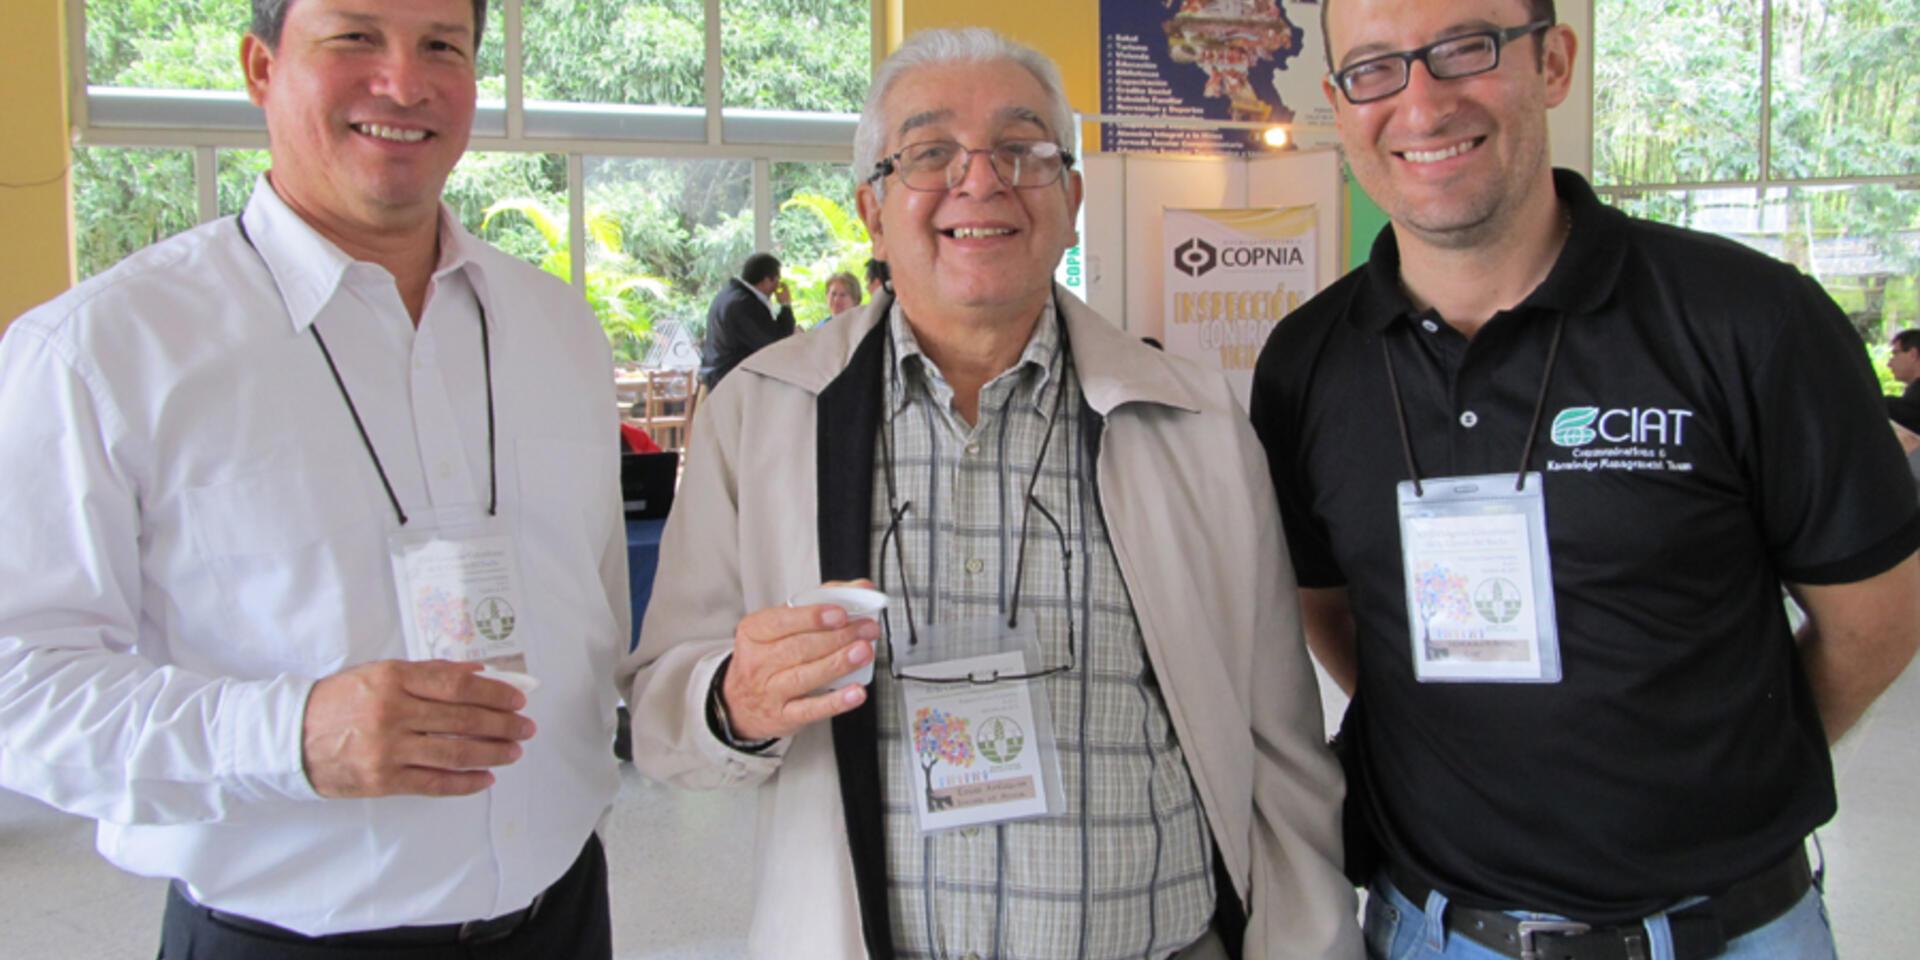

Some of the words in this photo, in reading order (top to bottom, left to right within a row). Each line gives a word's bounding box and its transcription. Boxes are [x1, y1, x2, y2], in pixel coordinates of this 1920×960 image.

[1066, 229, 1081, 287] COPN
[1222, 247, 1304, 268] COPNIA
[1200, 318, 1272, 351] CONTRO
[1598, 406, 1693, 446] CIAT
